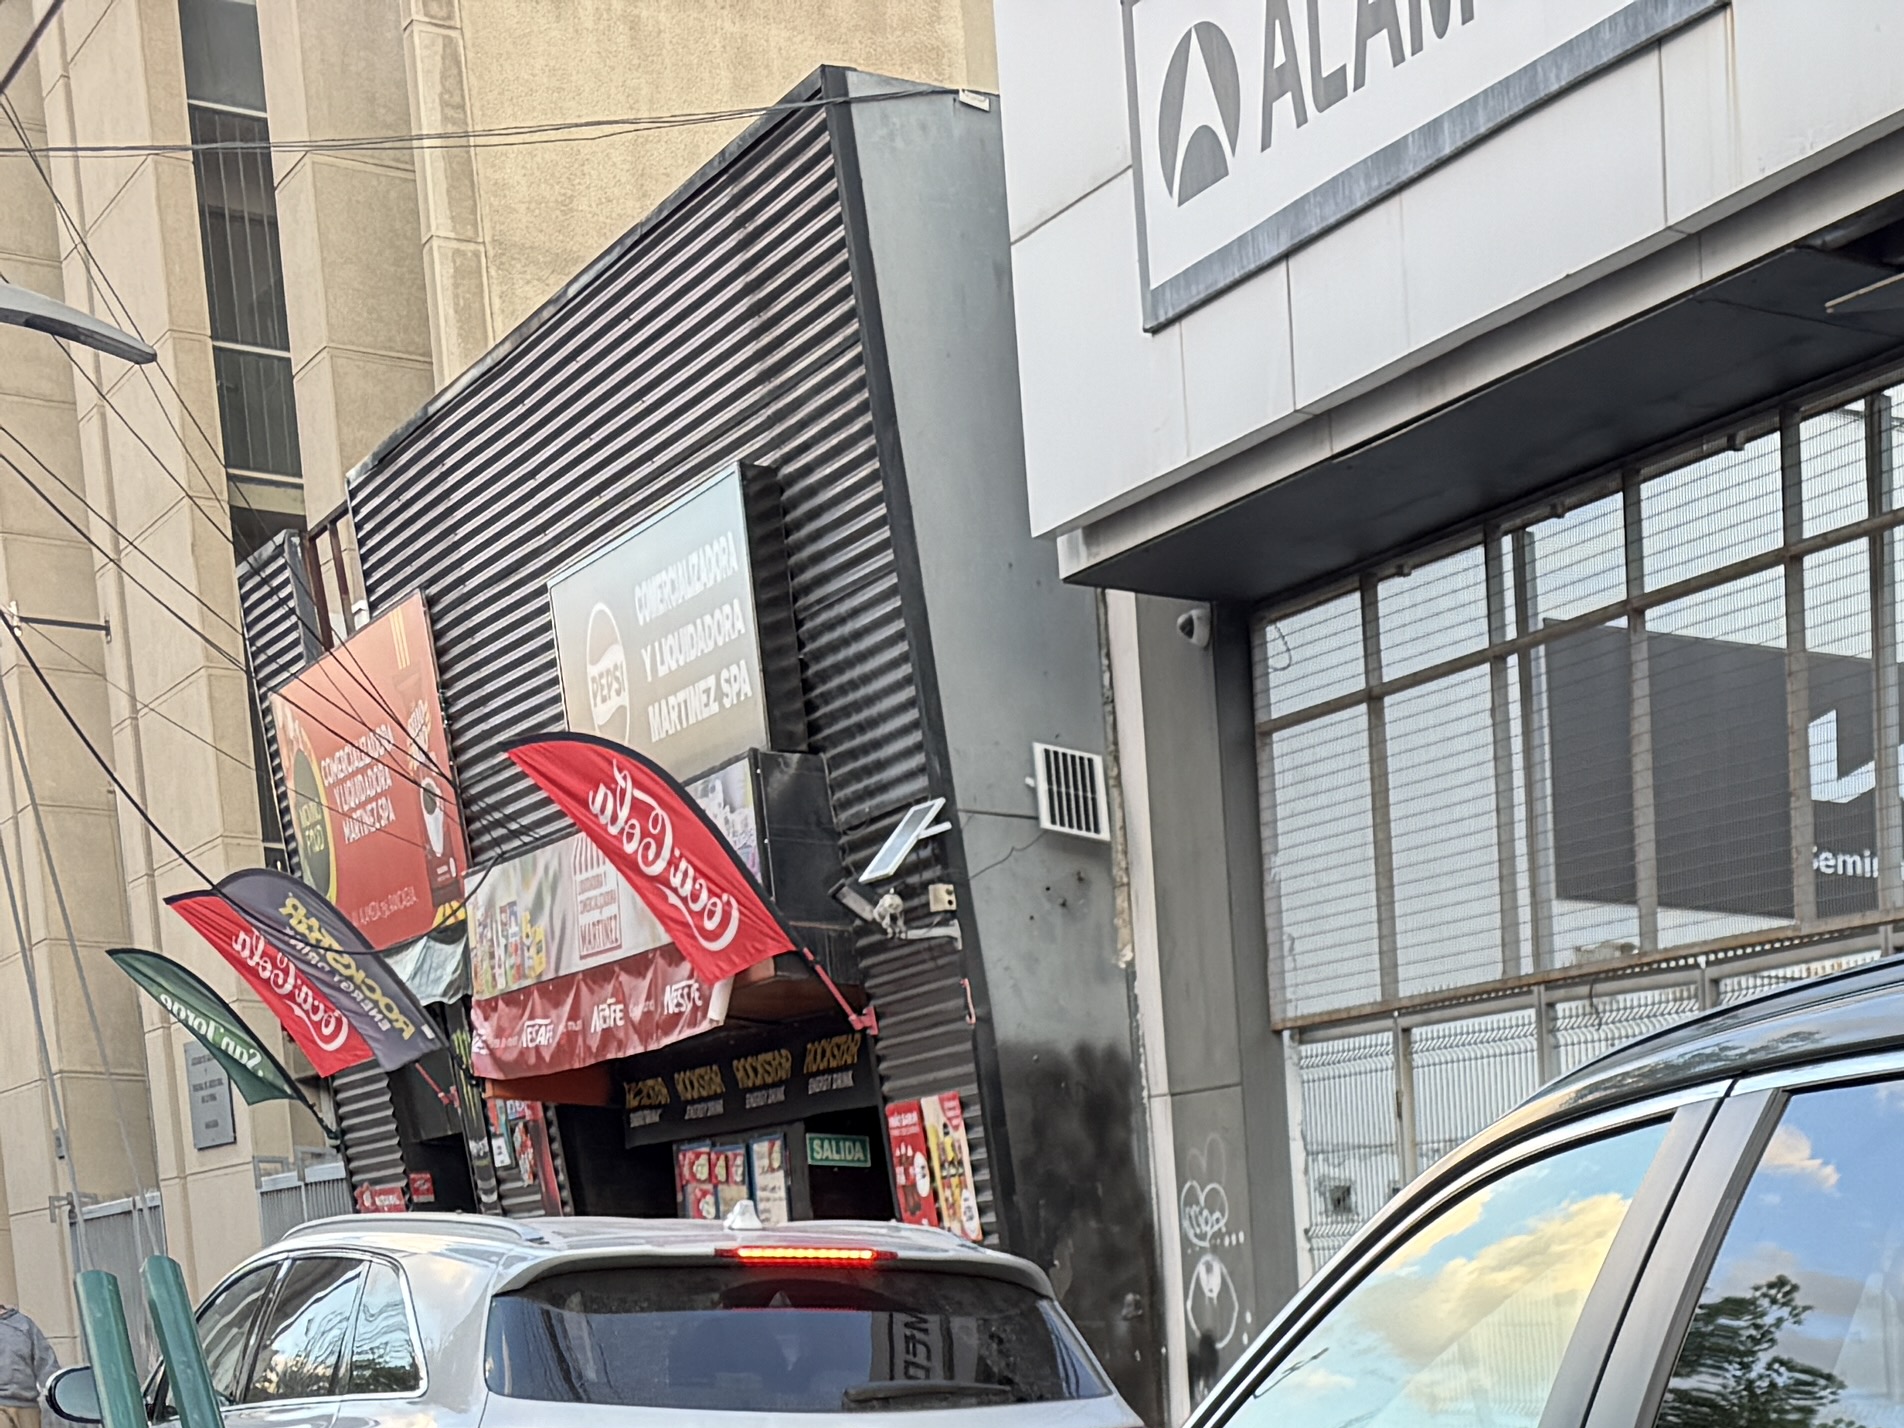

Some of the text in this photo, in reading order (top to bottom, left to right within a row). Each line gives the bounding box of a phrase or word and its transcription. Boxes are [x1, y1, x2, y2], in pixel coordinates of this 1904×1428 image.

[1261, 0, 1474, 153] ALA
[634, 531, 739, 626] COMERCIALIZADORA
[641, 598, 746, 682] Y LIQUIDADORA
[590, 659, 627, 711] PEPSI
[648, 658, 753, 743] MARTINEZ SPA
[732, 1048, 792, 1089] ROCKSTAR
[803, 1032, 862, 1074] ROCKSTAR
[812, 1138, 866, 1162] SALIDA
